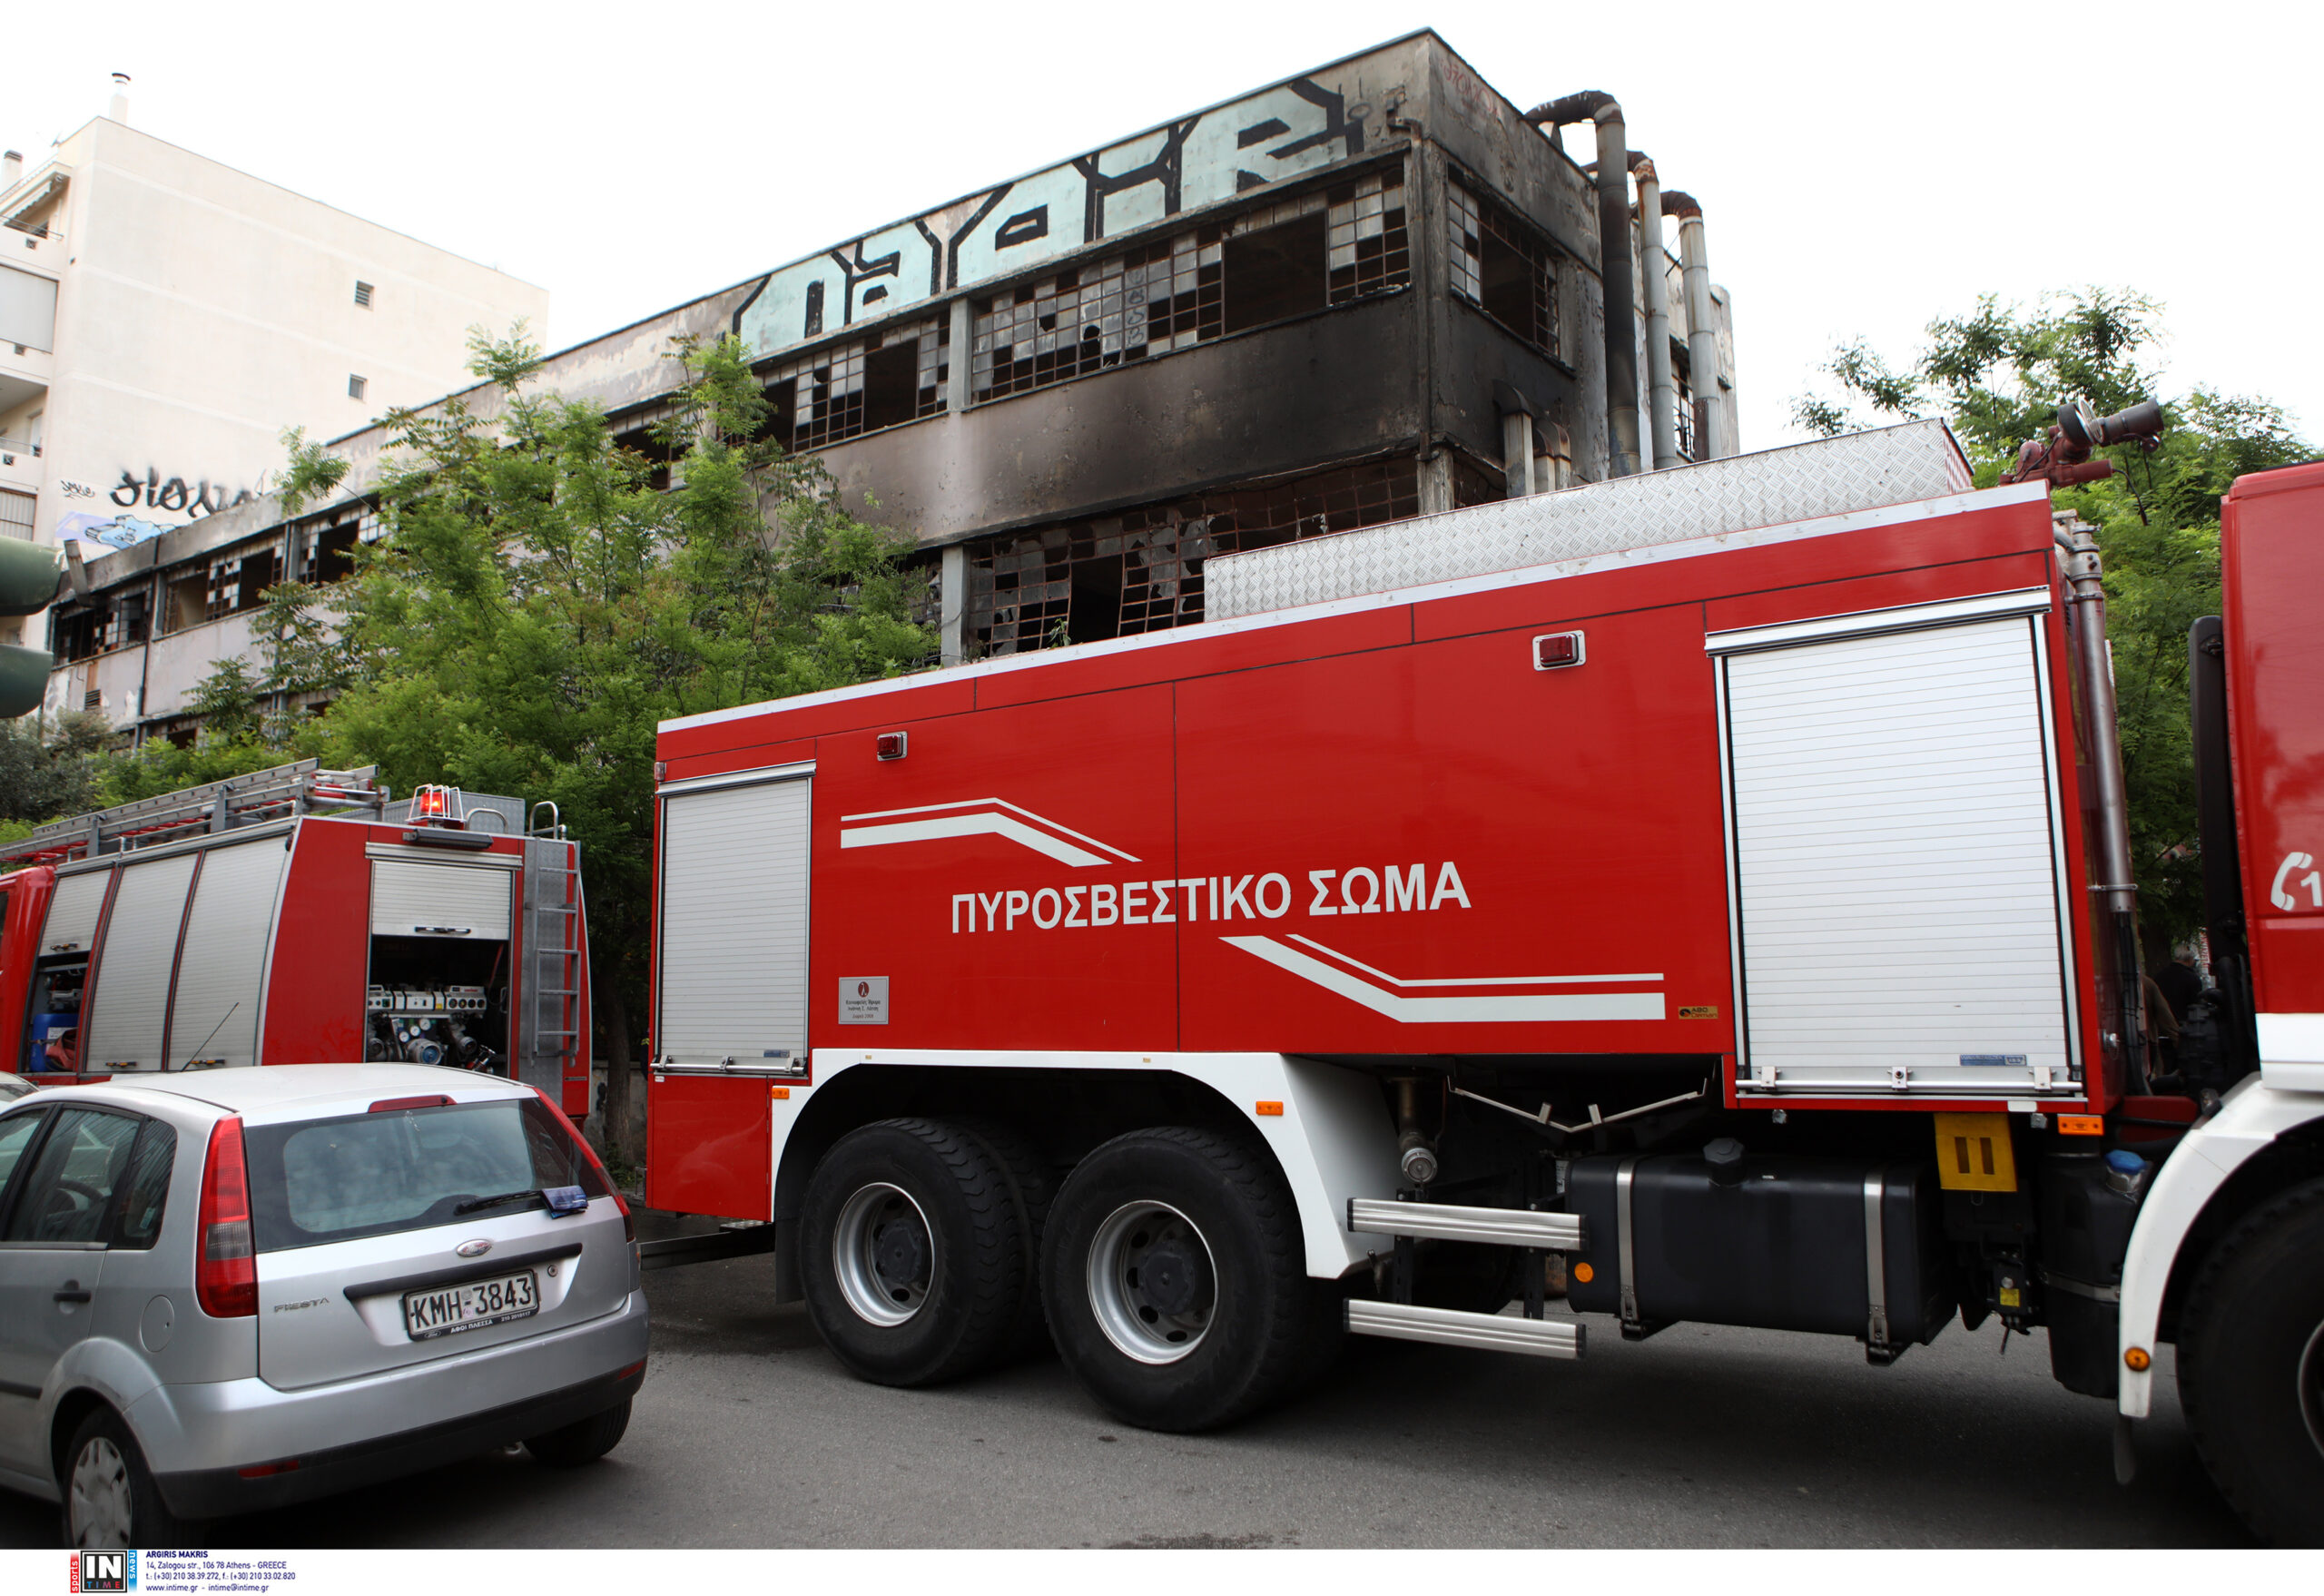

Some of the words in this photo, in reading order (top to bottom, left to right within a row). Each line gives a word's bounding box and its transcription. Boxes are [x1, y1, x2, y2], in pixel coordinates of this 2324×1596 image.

[951, 872, 1291, 933] ΠΥΡΟΣΒΕΣΤΙΚΟ
[1308, 862, 1472, 917] ΣΩΜΑ
[274, 1297, 330, 1313] FIESTA
[413, 1276, 532, 1328] KMH-3843
